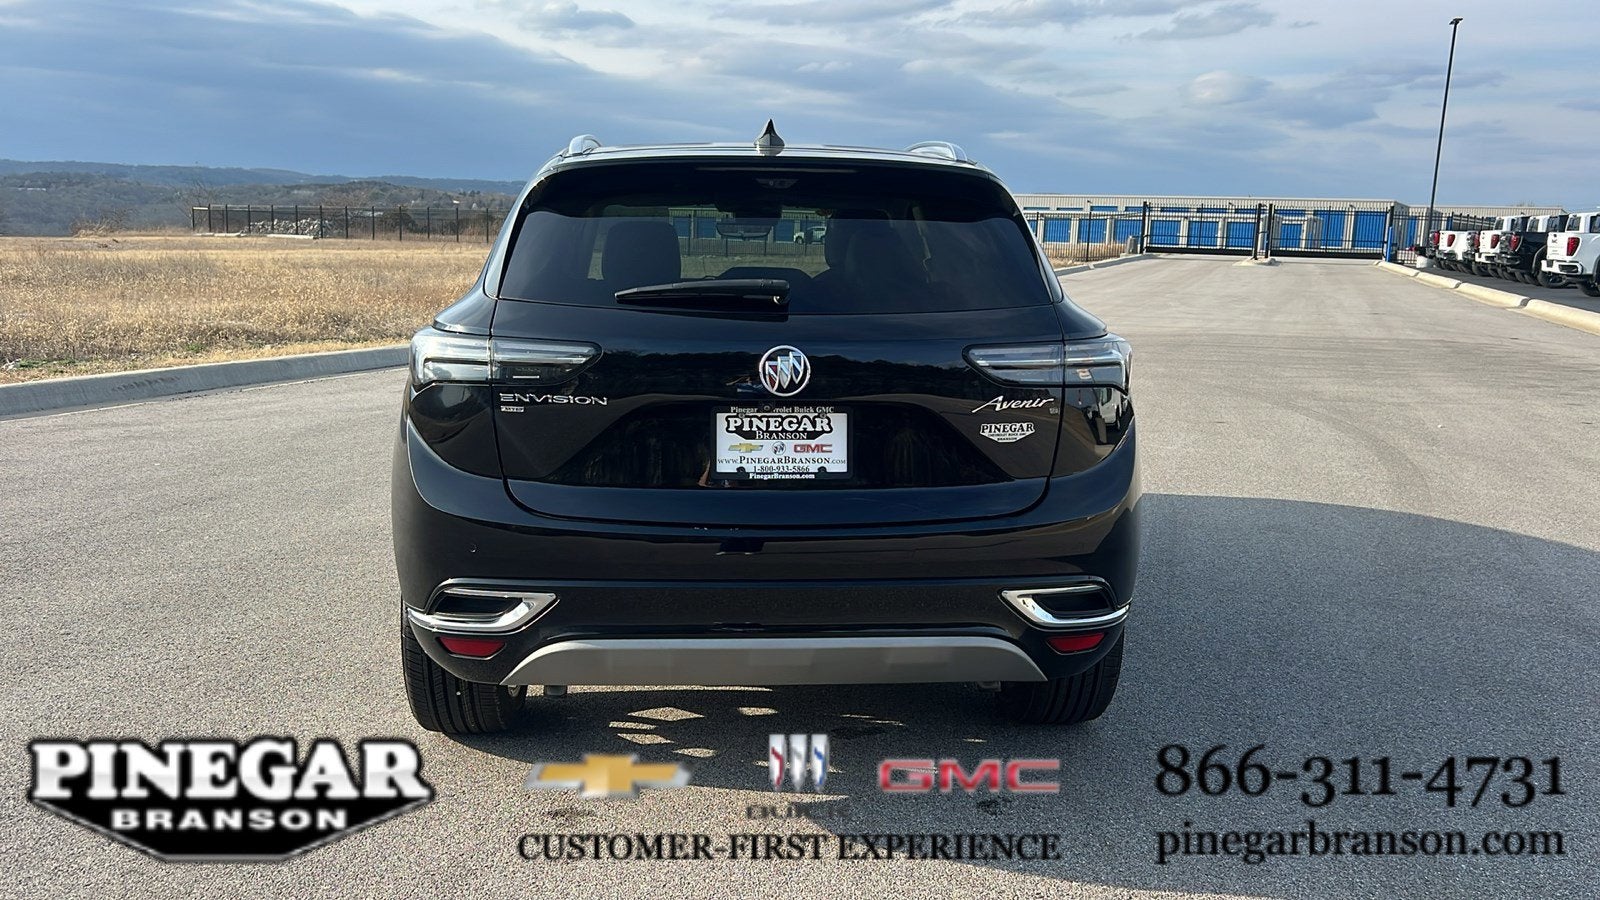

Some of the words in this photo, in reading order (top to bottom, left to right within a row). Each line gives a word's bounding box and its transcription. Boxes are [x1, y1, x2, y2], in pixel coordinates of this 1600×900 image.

[500, 393, 607, 405] ENVISION
[972, 395, 1054, 413] Avenir
[727, 417, 832, 431] PINEGAR
[981, 423, 1034, 433] PINEGAR
[755, 431, 807, 440] BRANSON
[793, 444, 833, 453] GMC
